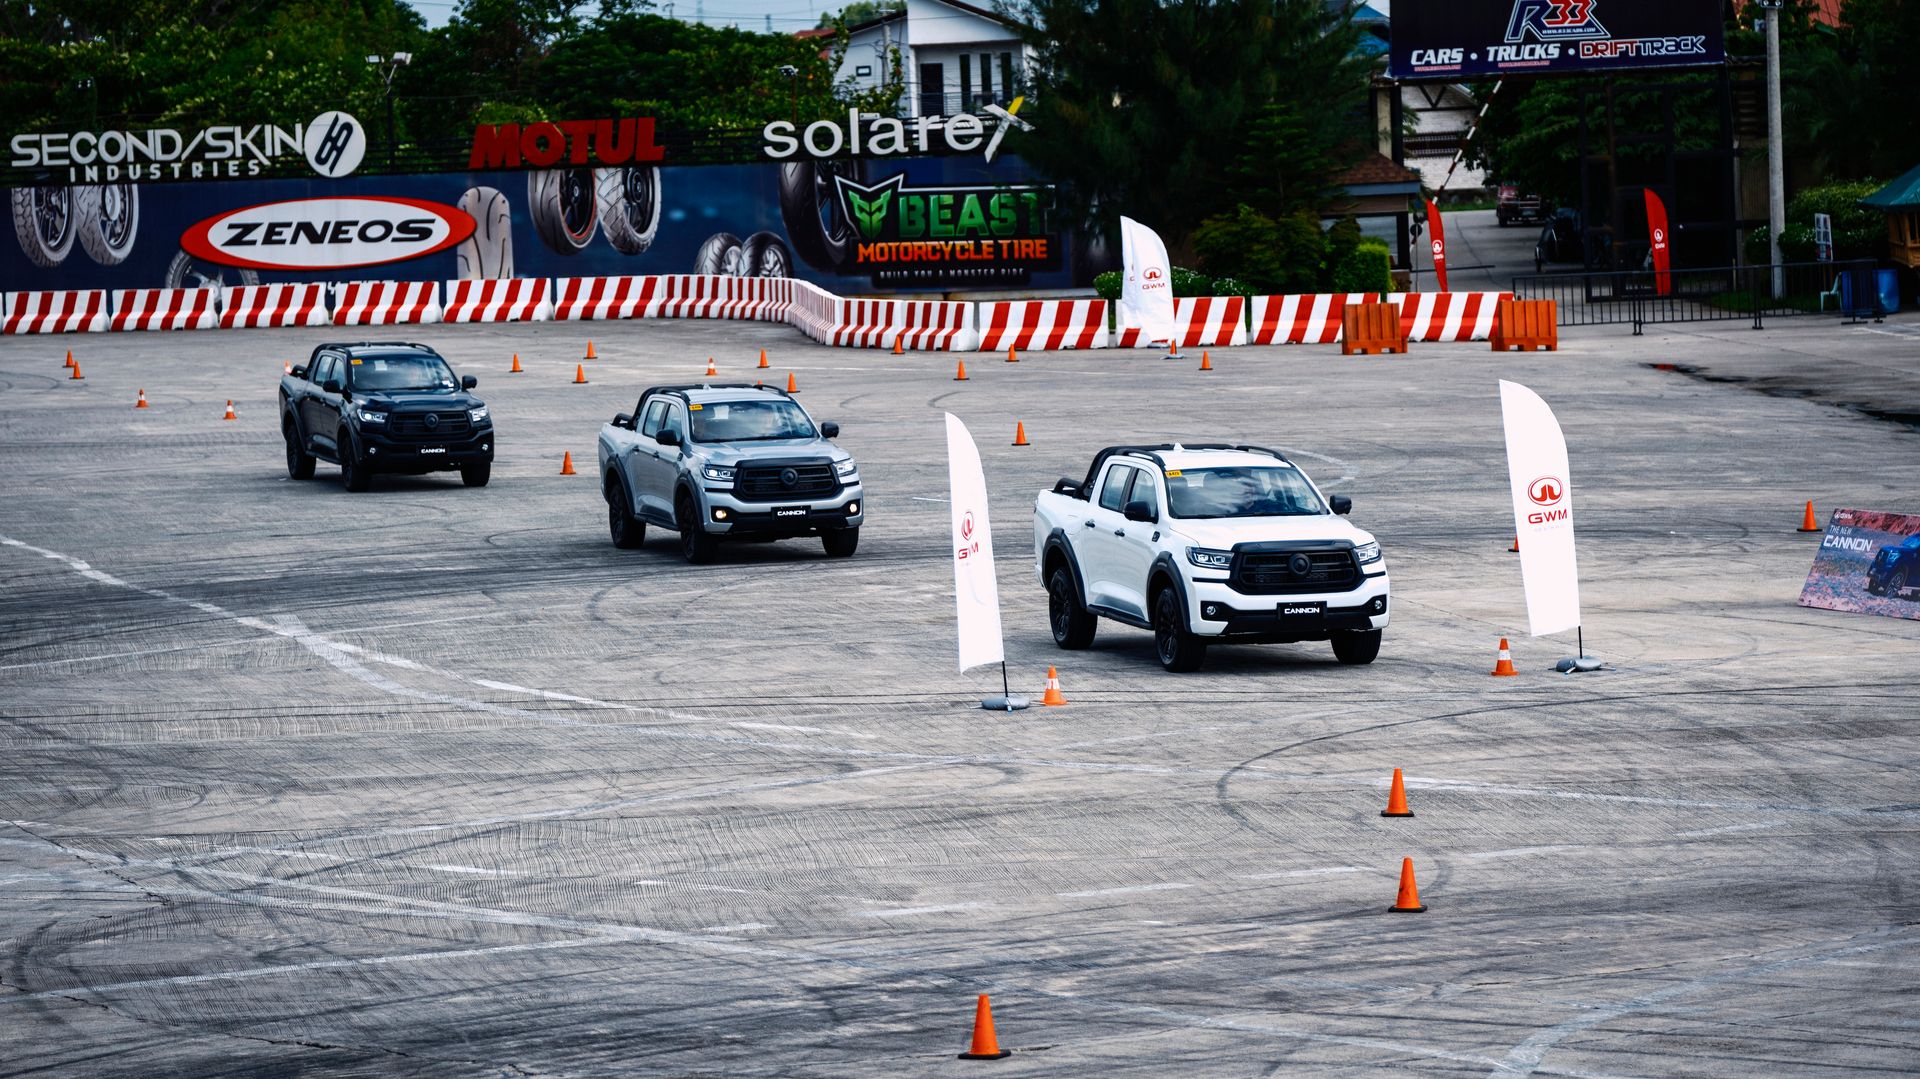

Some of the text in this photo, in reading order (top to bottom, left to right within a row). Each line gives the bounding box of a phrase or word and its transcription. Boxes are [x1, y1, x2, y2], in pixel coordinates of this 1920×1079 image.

[1504, 0, 1611, 42] R33
[1411, 48, 1464, 65] CARS
[1487, 43, 1561, 61] TRUCKS
[763, 96, 1036, 163] solarex
[11, 123, 303, 167] SECOND/SKIN
[469, 117, 666, 169] MOTUL
[70, 160, 260, 182] INDUSTRIES
[899, 193, 1042, 237] BEAST
[221, 218, 436, 246] ZENEOS
[857, 239, 1048, 263] MOTORCYCLE TIRE
[1528, 509, 1567, 524] GWM
[1829, 525, 1853, 535] THE NEW
[958, 541, 979, 560] GM
[1823, 535, 1873, 551] CANNON
